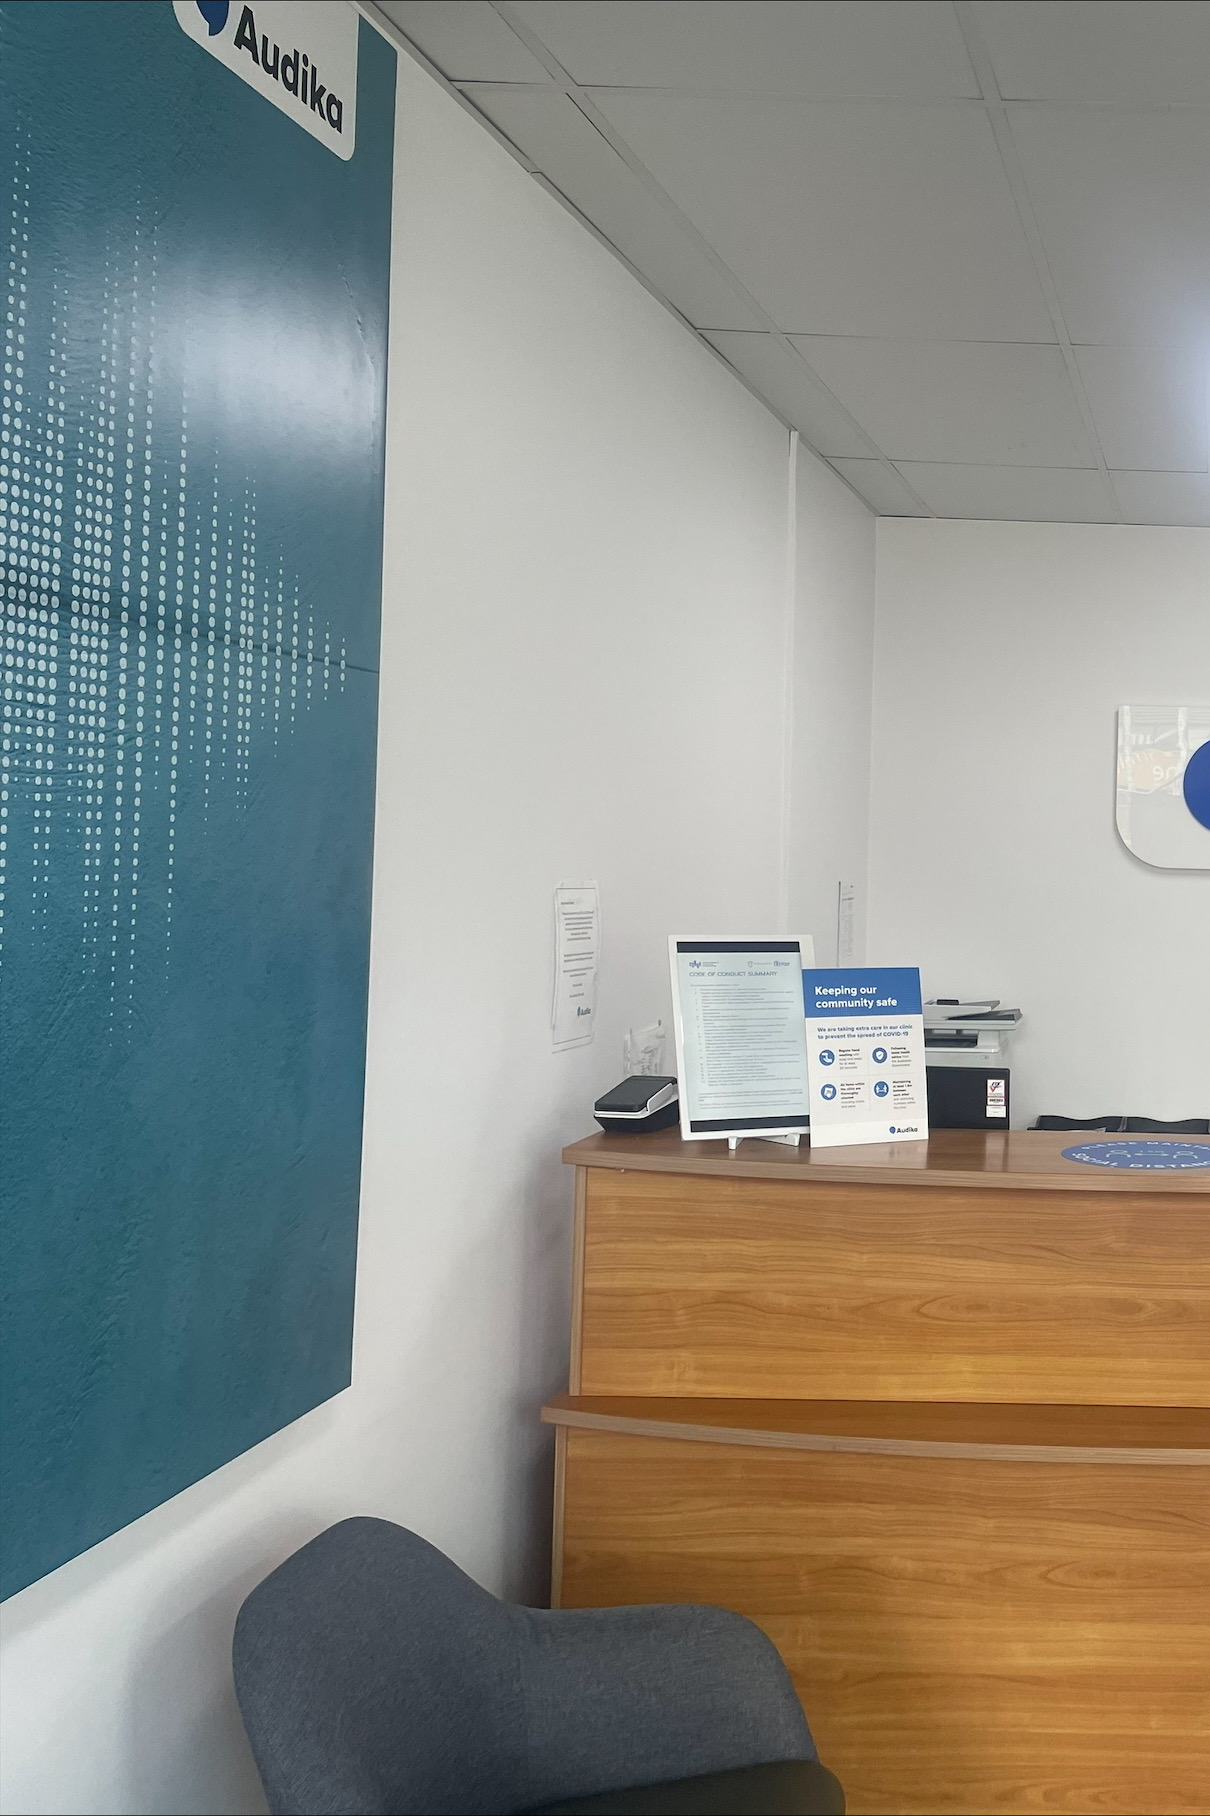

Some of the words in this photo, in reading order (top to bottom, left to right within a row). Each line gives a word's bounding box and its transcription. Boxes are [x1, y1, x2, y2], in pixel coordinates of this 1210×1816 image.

[233, 4, 343, 134] Audika
[815, 985, 857, 997] Keeping
[816, 997, 874, 1009] community
[876, 997, 897, 1006] safe
[837, 1025, 855, 1033] taking
